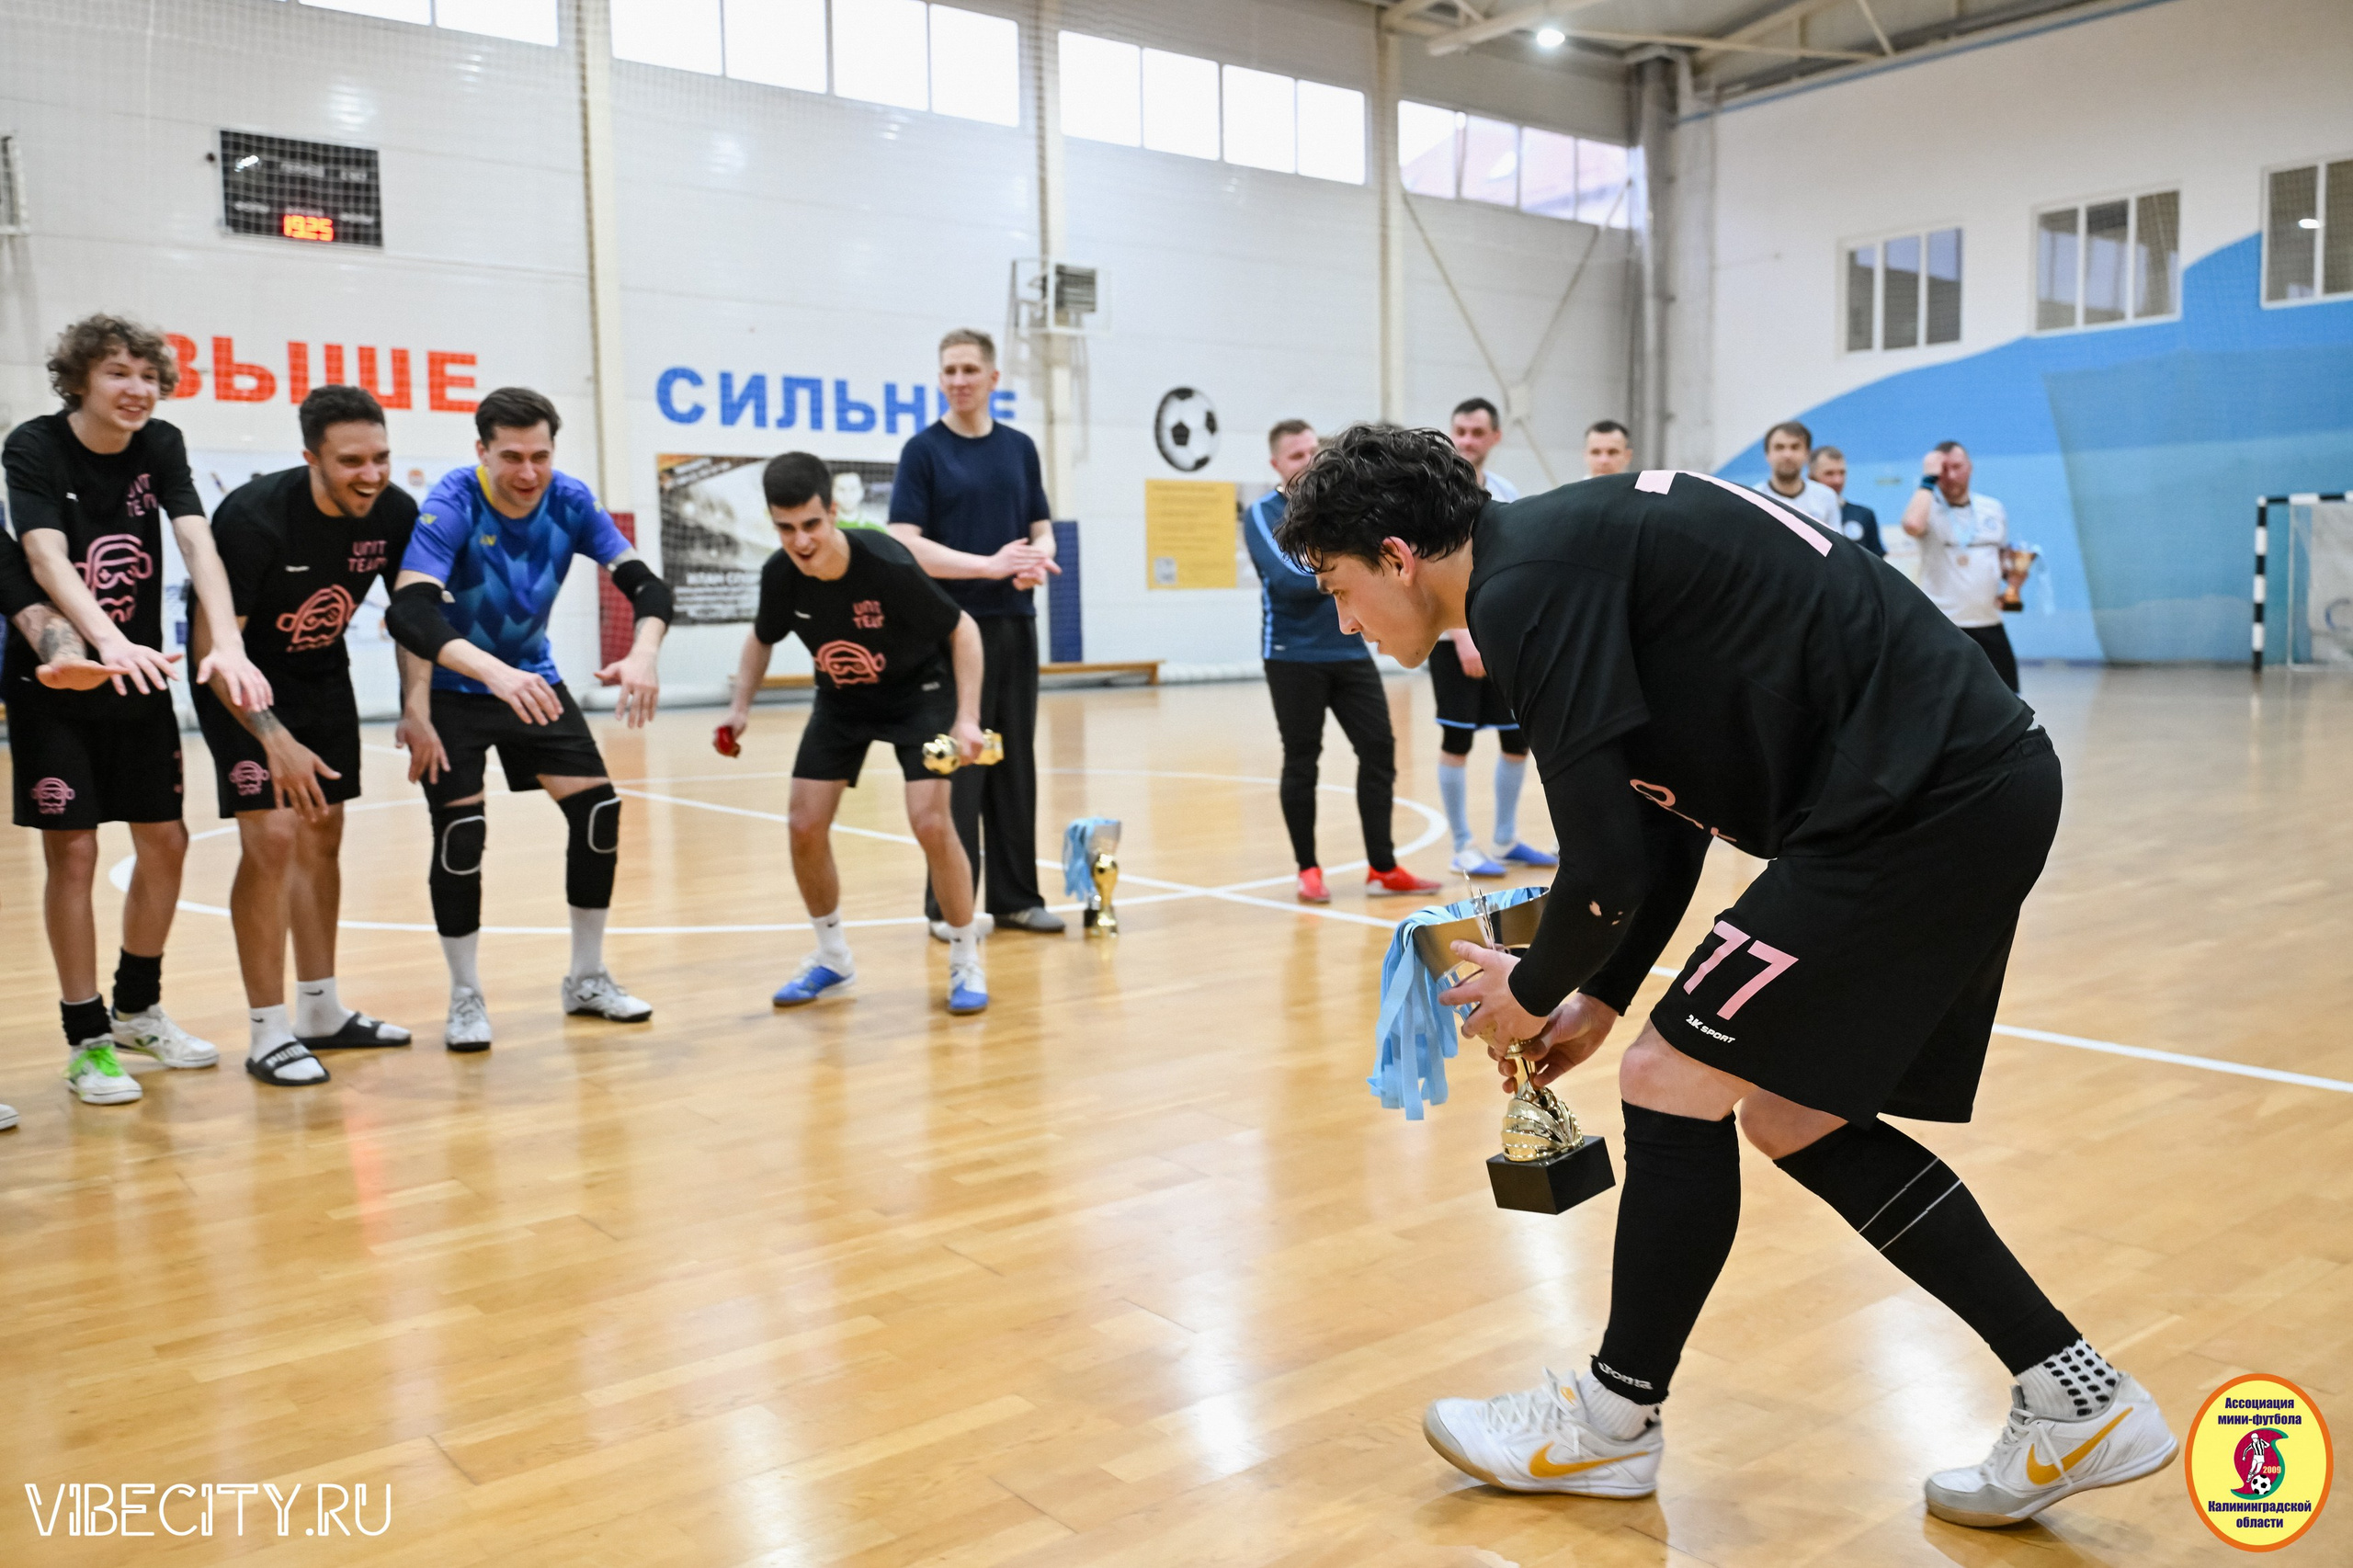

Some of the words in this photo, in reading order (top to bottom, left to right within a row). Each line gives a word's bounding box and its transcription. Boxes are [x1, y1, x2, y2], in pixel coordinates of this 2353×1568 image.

[165, 334, 479, 414] ВЫШЕ
[656, 367, 1016, 434] СИЛЬНЕ
[1682, 919, 1800, 1021] 77
[1685, 1014, 1703, 1029] 2K
[1699, 1025, 1736, 1044] SPORT
